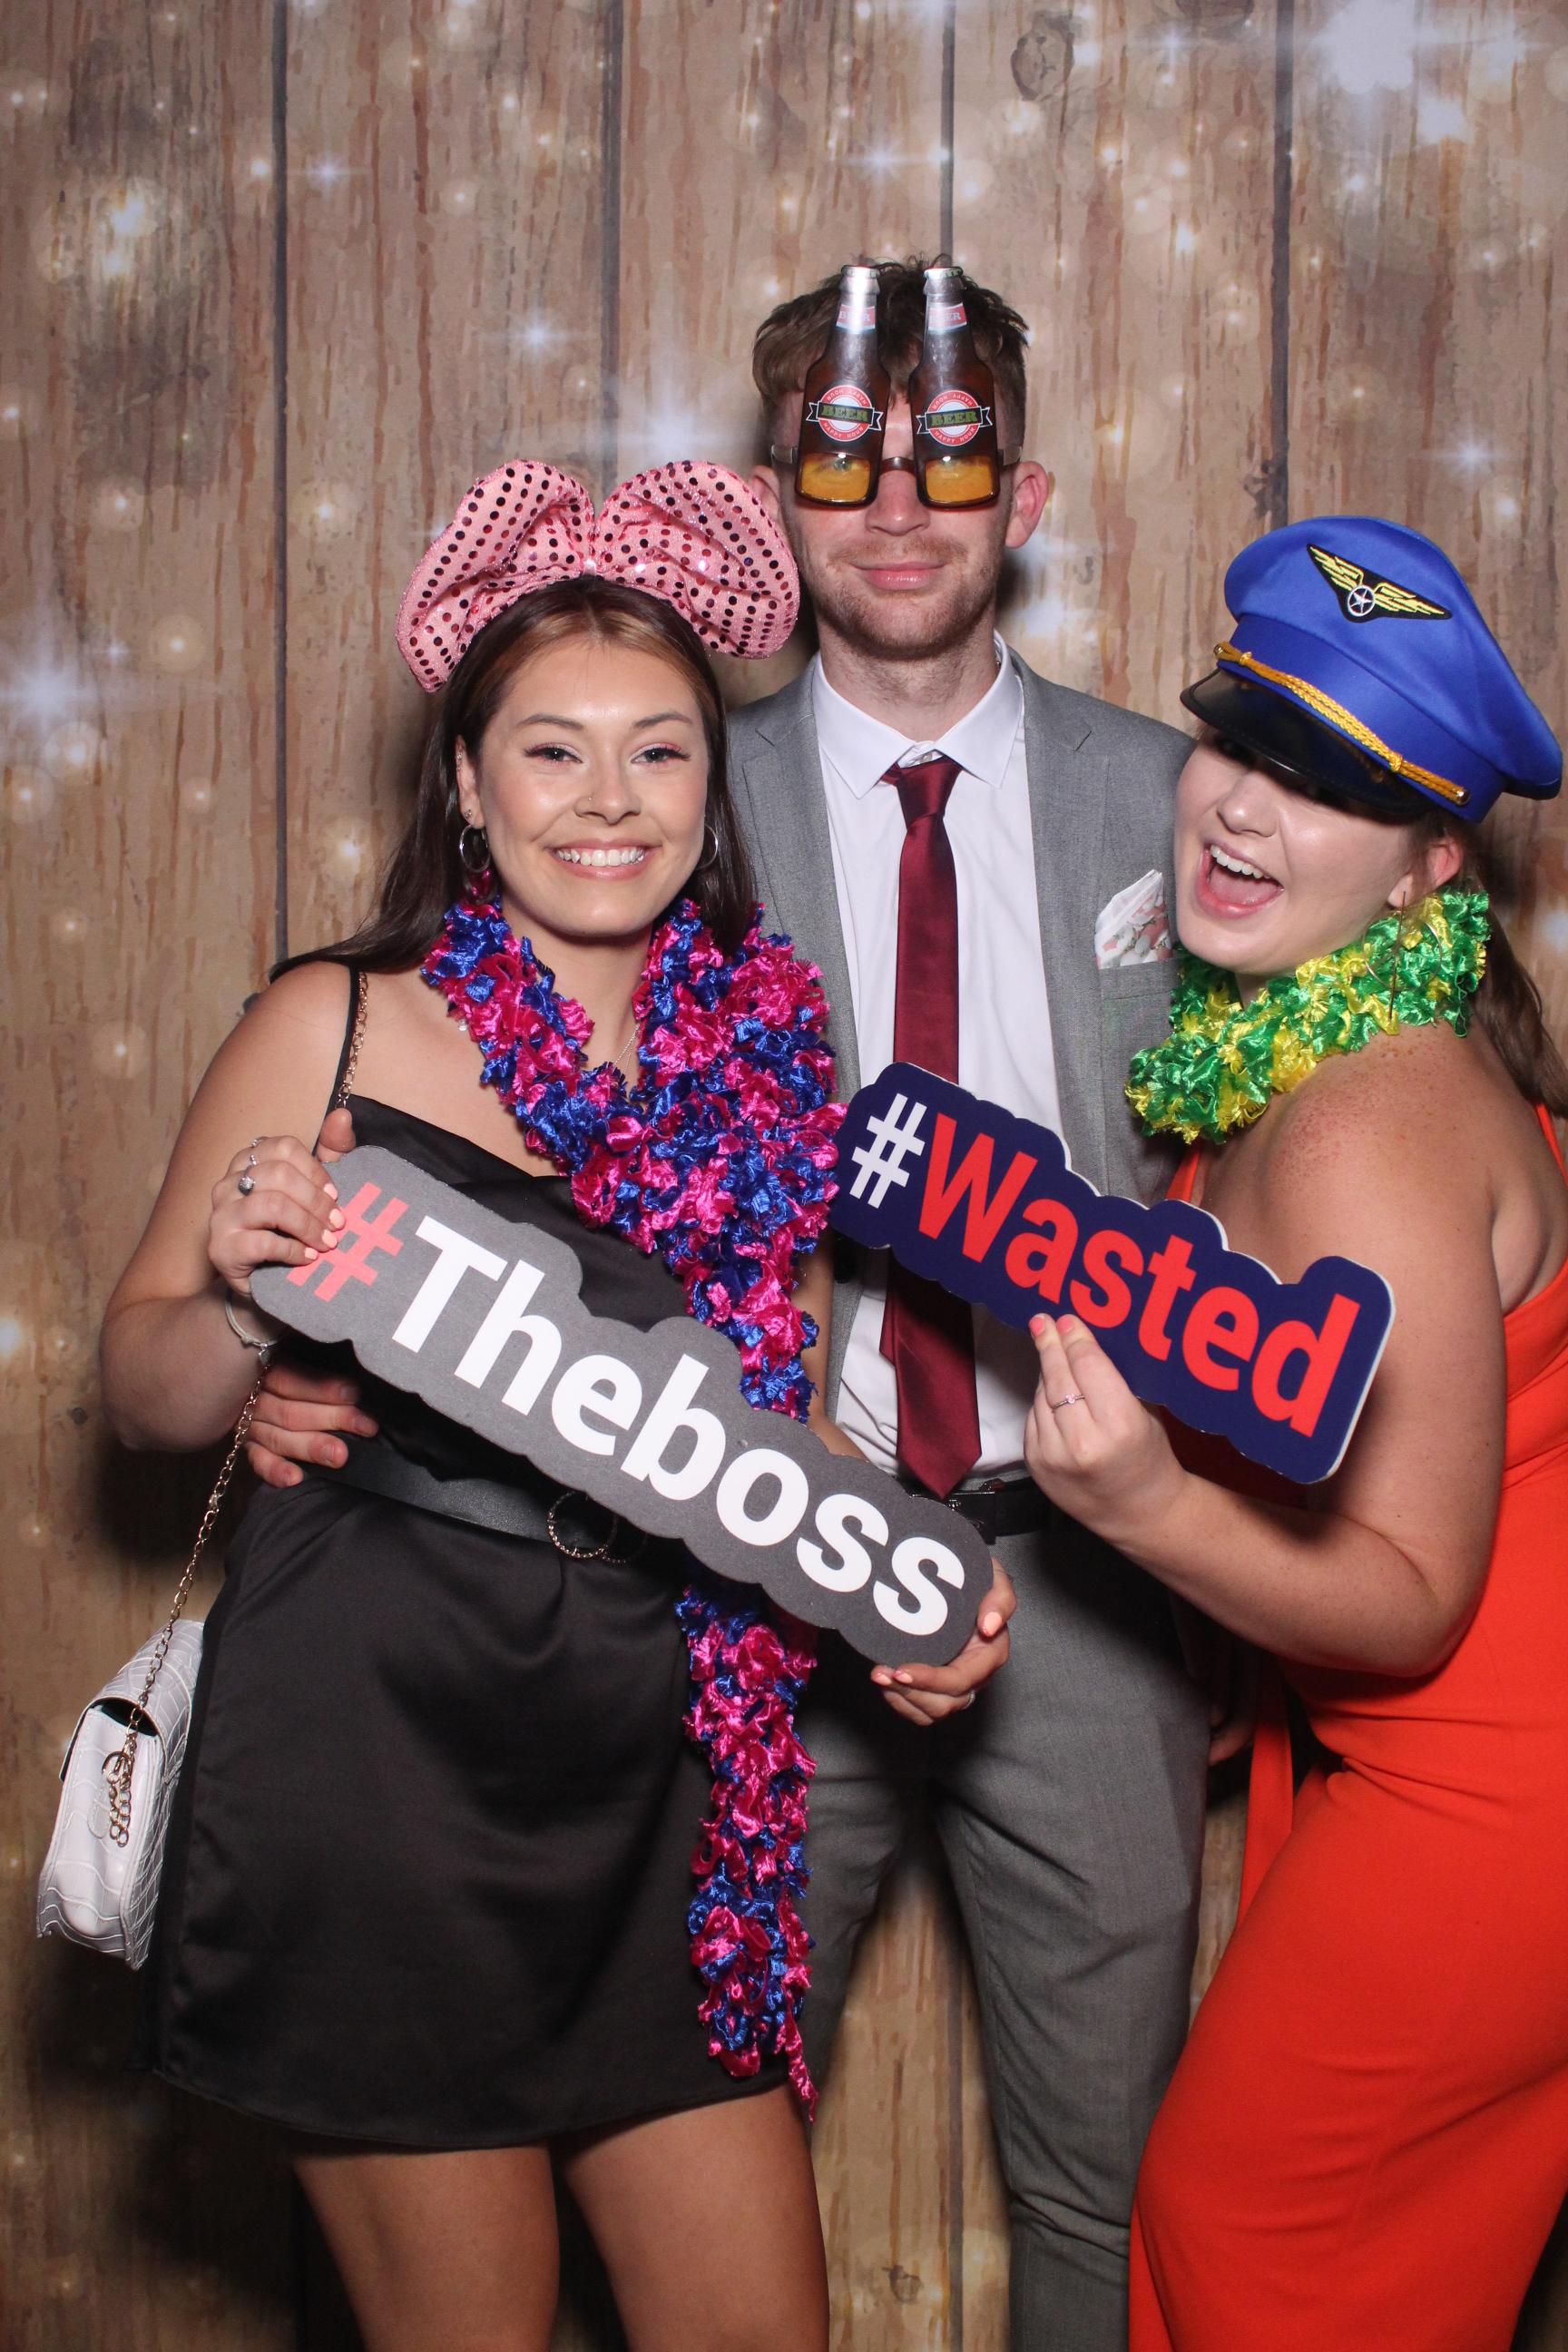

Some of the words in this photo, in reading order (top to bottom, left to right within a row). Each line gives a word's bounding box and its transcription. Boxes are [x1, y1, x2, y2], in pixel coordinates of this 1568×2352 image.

[838, 310, 871, 322] BR
[930, 311, 962, 323] ER
[822, 405, 868, 422] BEER
[931, 411, 978, 426] BEER
[822, 422, 842, 437] HAPPY
[847, 426, 865, 439] HOUR
[934, 431, 956, 445] HAPPY
[960, 426, 976, 443] HOUR
[850, 1093, 1360, 1437] #Wasted
[286, 1181, 965, 1636] #Theboss
